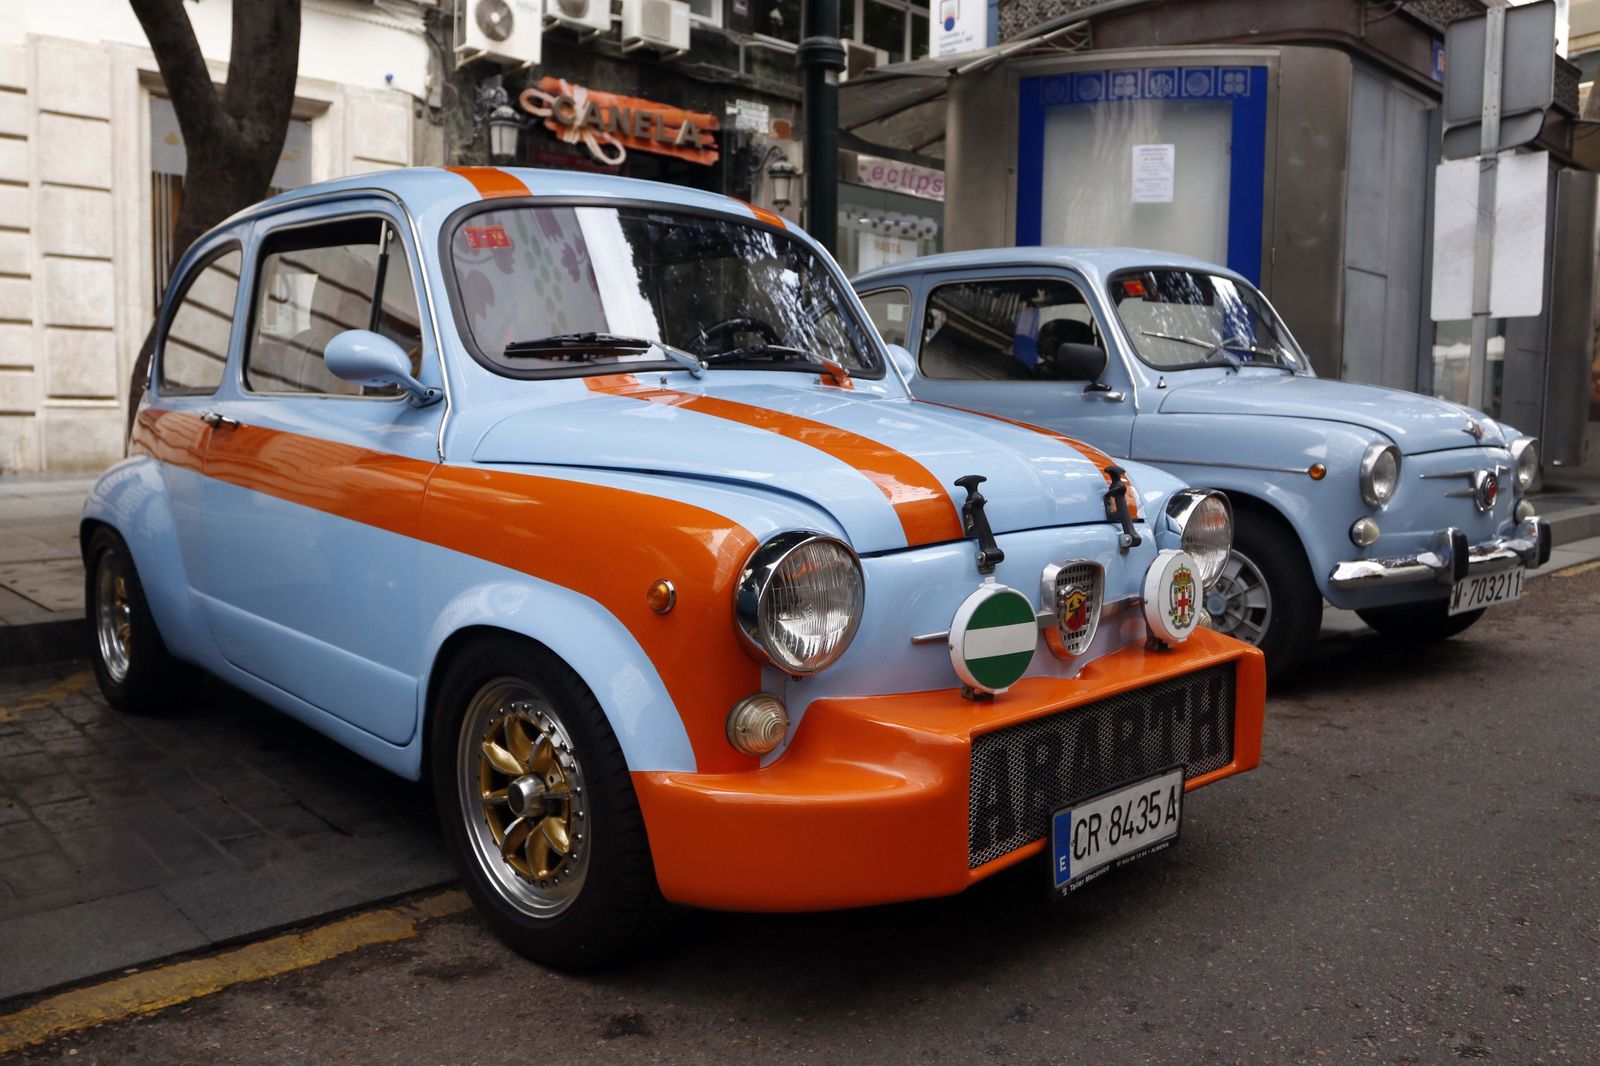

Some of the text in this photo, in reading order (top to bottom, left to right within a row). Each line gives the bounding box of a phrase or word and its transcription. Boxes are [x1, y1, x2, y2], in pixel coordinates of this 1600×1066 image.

[553, 95, 703, 149] CANELA
[967, 670, 1226, 853] ABARTH
[1073, 784, 1178, 861] CR 8435 A
[1060, 855, 1067, 872] E
